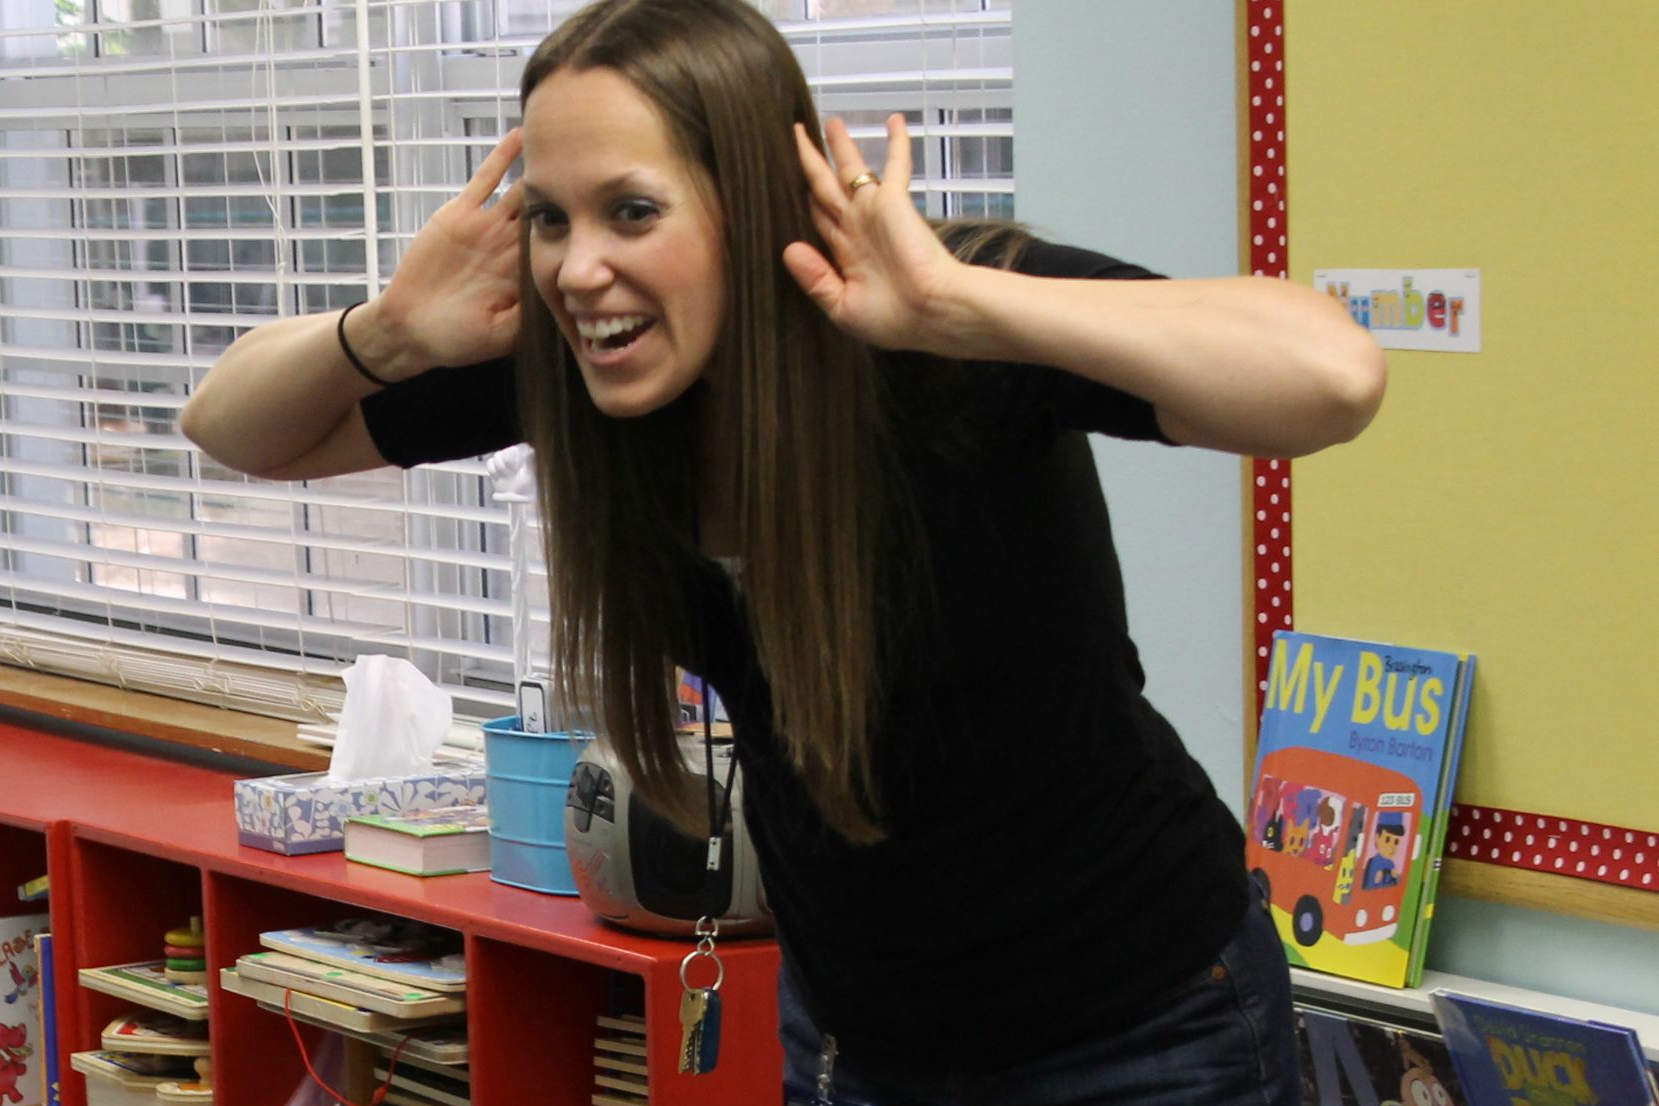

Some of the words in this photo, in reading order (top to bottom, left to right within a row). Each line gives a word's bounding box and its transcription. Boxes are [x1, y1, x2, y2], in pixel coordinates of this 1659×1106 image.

[1266, 639, 1345, 734] My
[1350, 650, 1444, 736] Bus
[1348, 731, 1385, 754] Byron
[1388, 738, 1434, 762] Barton
[1484, 1034, 1599, 1106] DUCK
